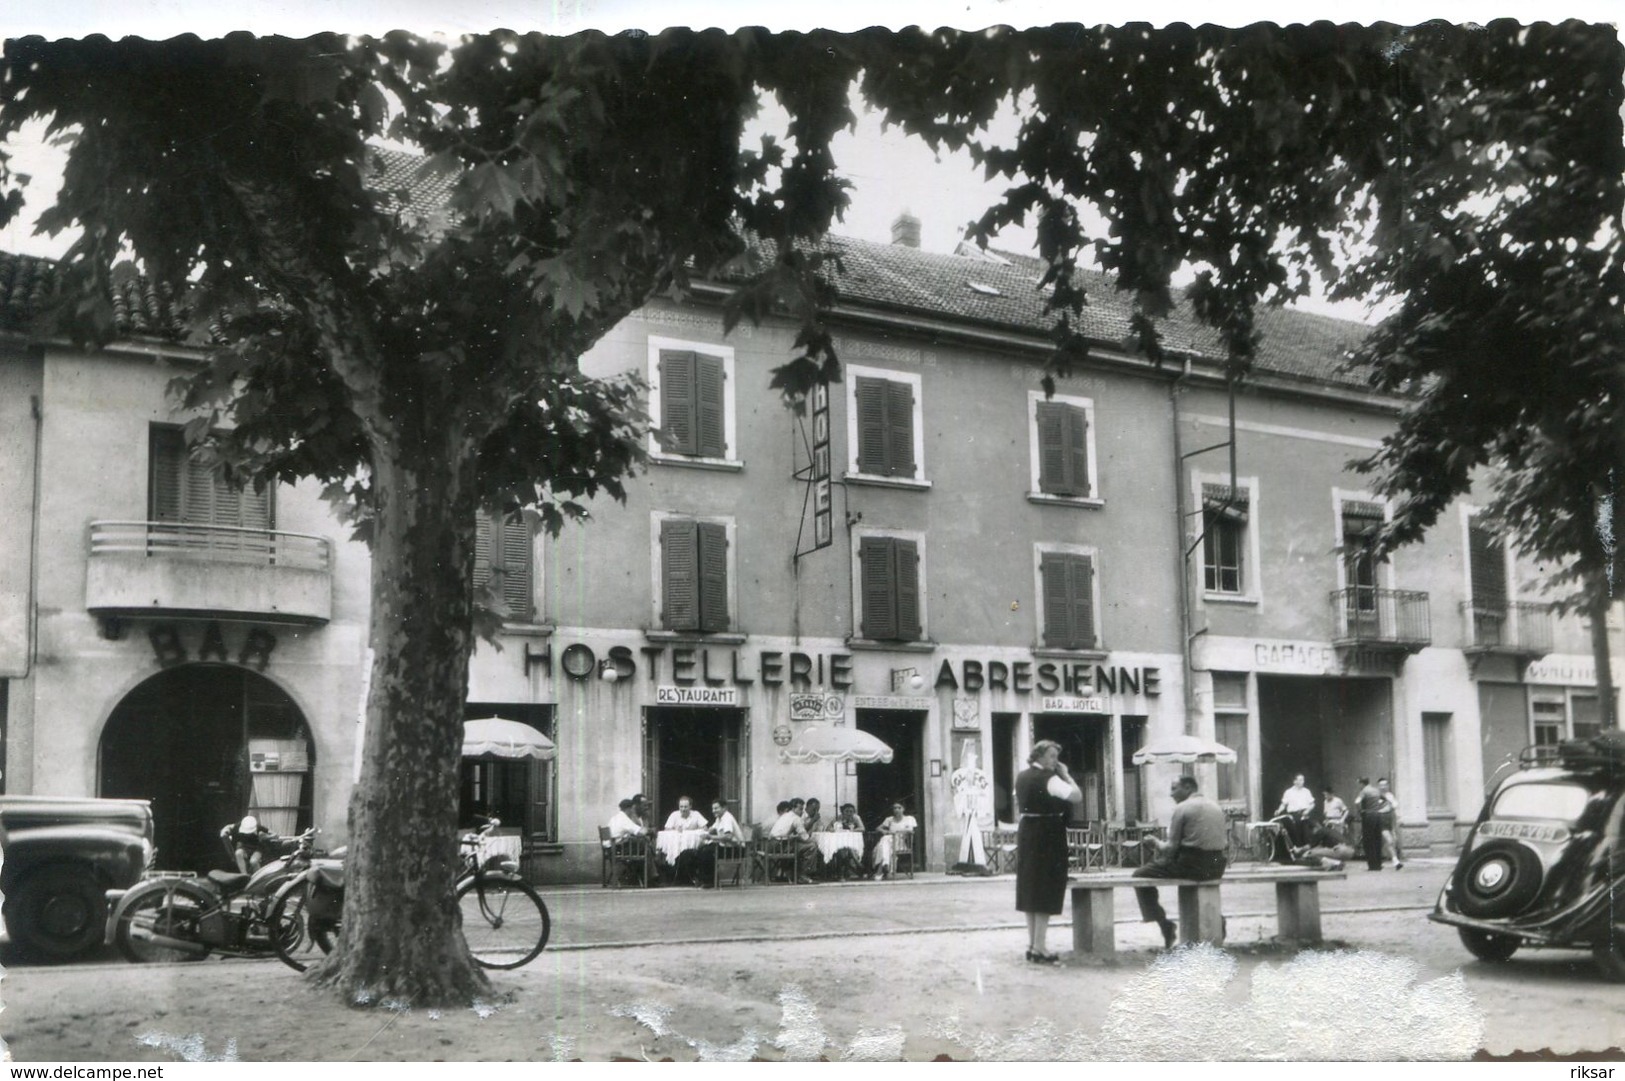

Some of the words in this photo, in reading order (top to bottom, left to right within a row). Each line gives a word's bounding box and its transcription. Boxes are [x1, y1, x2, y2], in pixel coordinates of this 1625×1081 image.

[153, 621, 277, 672] BAR
[524, 642, 853, 686] HOSTELLERIE
[935, 659, 1162, 697] ABRESIENNE
[658, 688, 735, 703] RESTAURANT
[1045, 698, 1063, 710] BAR
[1072, 698, 1102, 712] HOTEL
